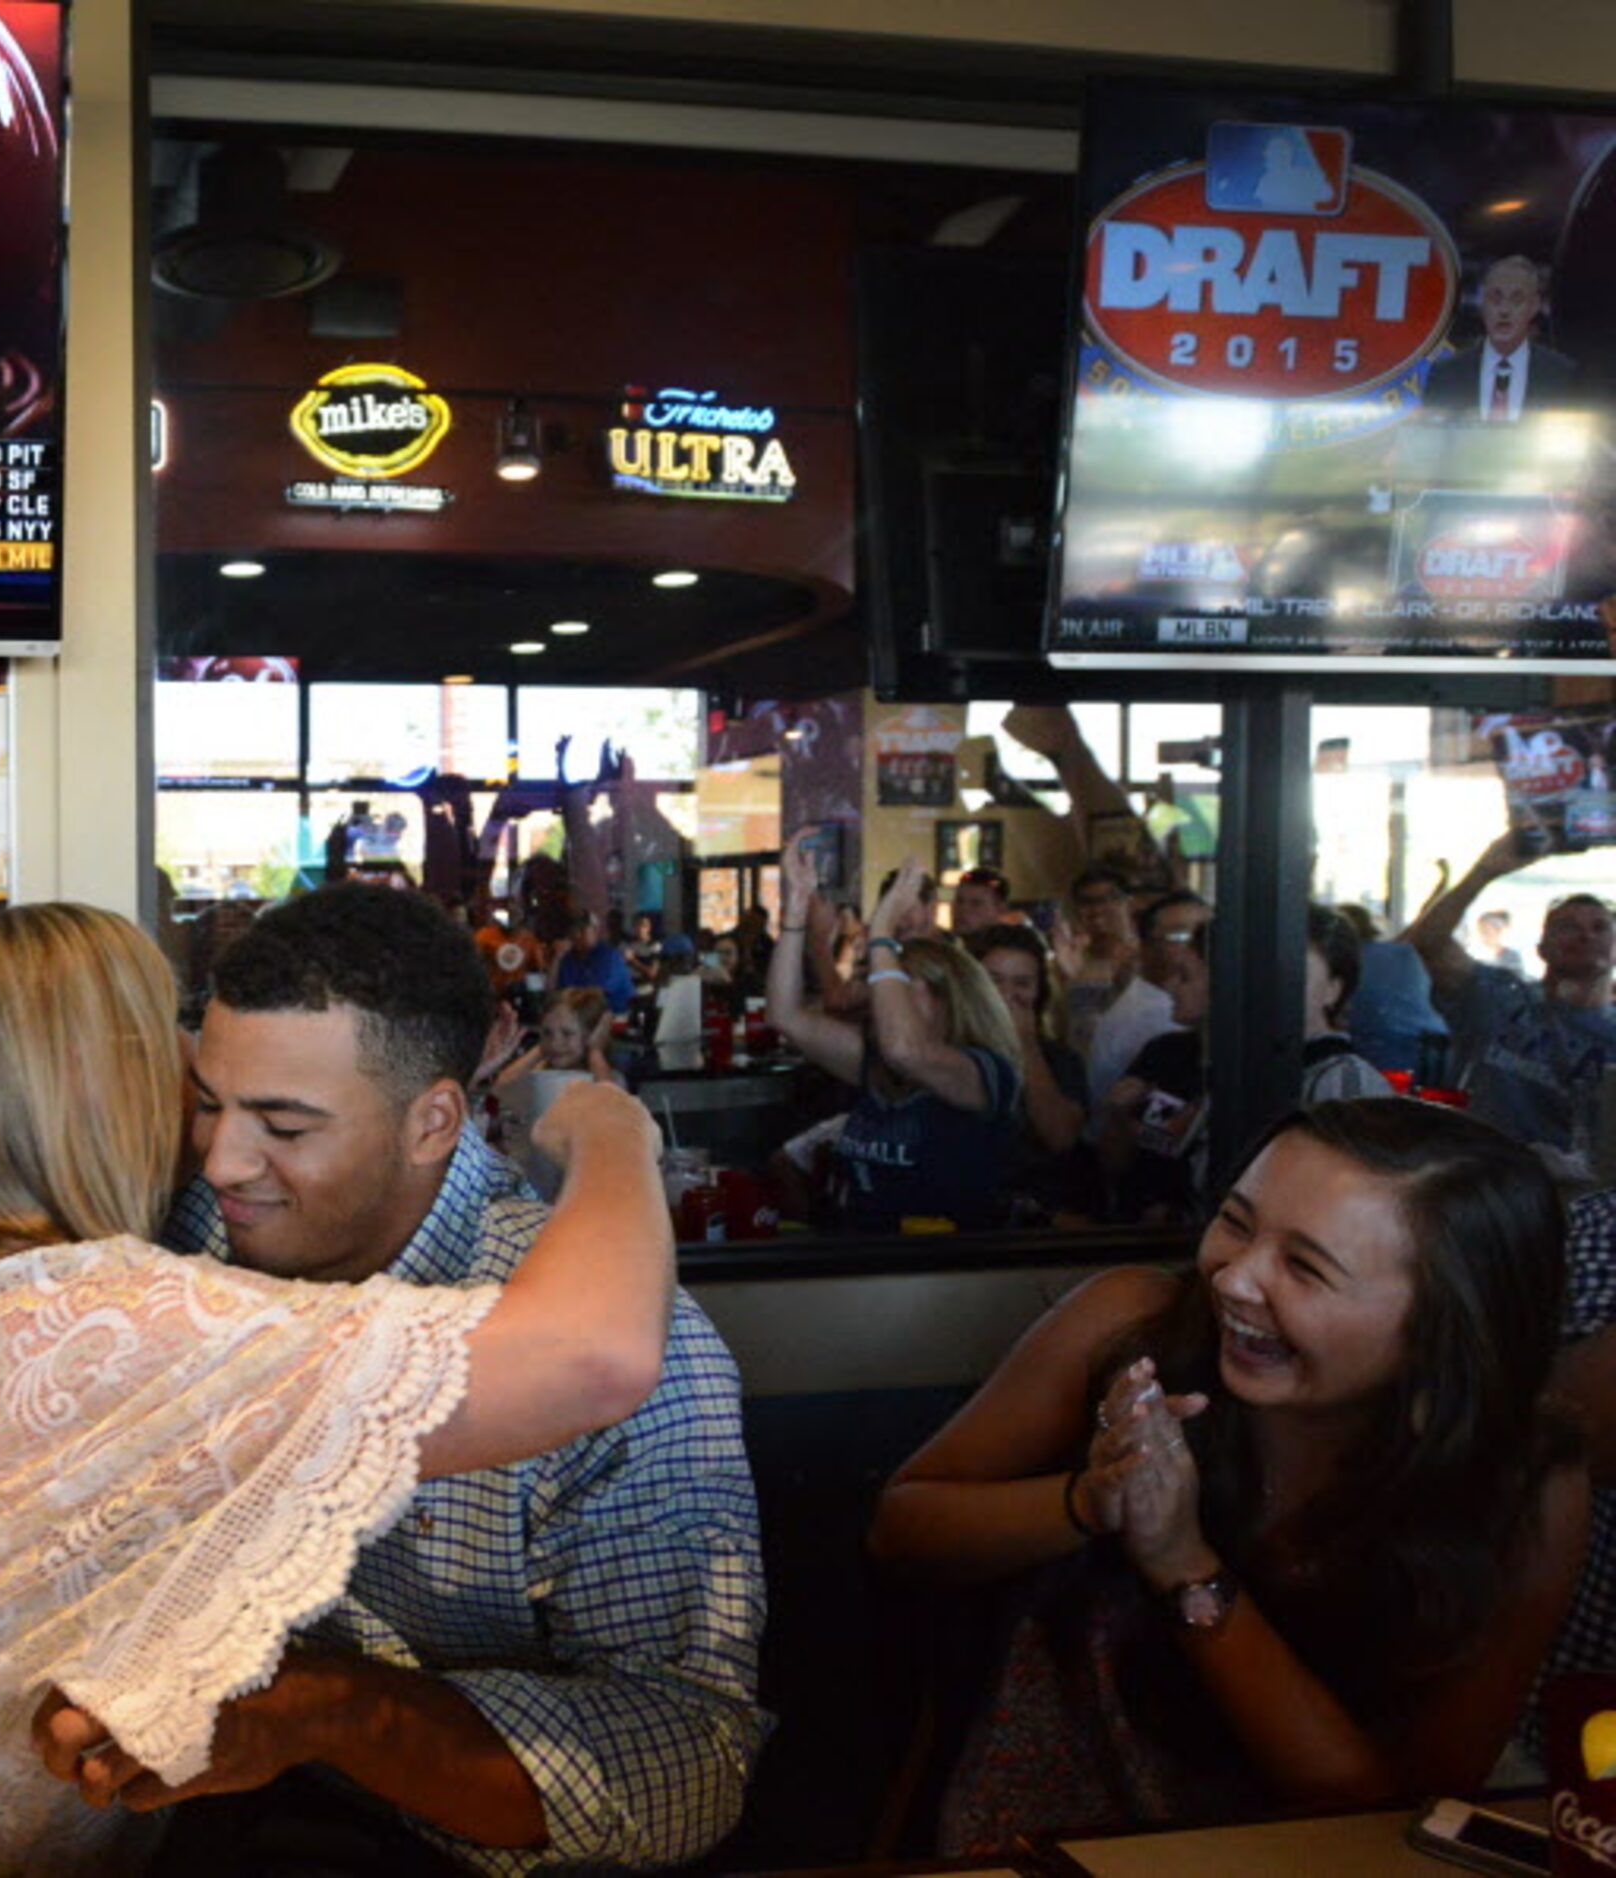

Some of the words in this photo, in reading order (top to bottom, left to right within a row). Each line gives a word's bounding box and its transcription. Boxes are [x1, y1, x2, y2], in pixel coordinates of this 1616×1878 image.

[1100, 220, 1433, 321] DRAFT
[1170, 333, 1358, 370] 2015
[318, 394, 427, 436] mike's
[8, 444, 45, 465] PIT
[609, 428, 796, 486] ULTRA
[8, 470, 36, 490] SF
[7, 495, 50, 515] CLE
[7, 521, 52, 540] NYY
[8, 548, 52, 568] MIL
[1424, 550, 1531, 578] DRAFT
[1089, 618, 1123, 636] AIR
[1174, 620, 1232, 639] MLBN
